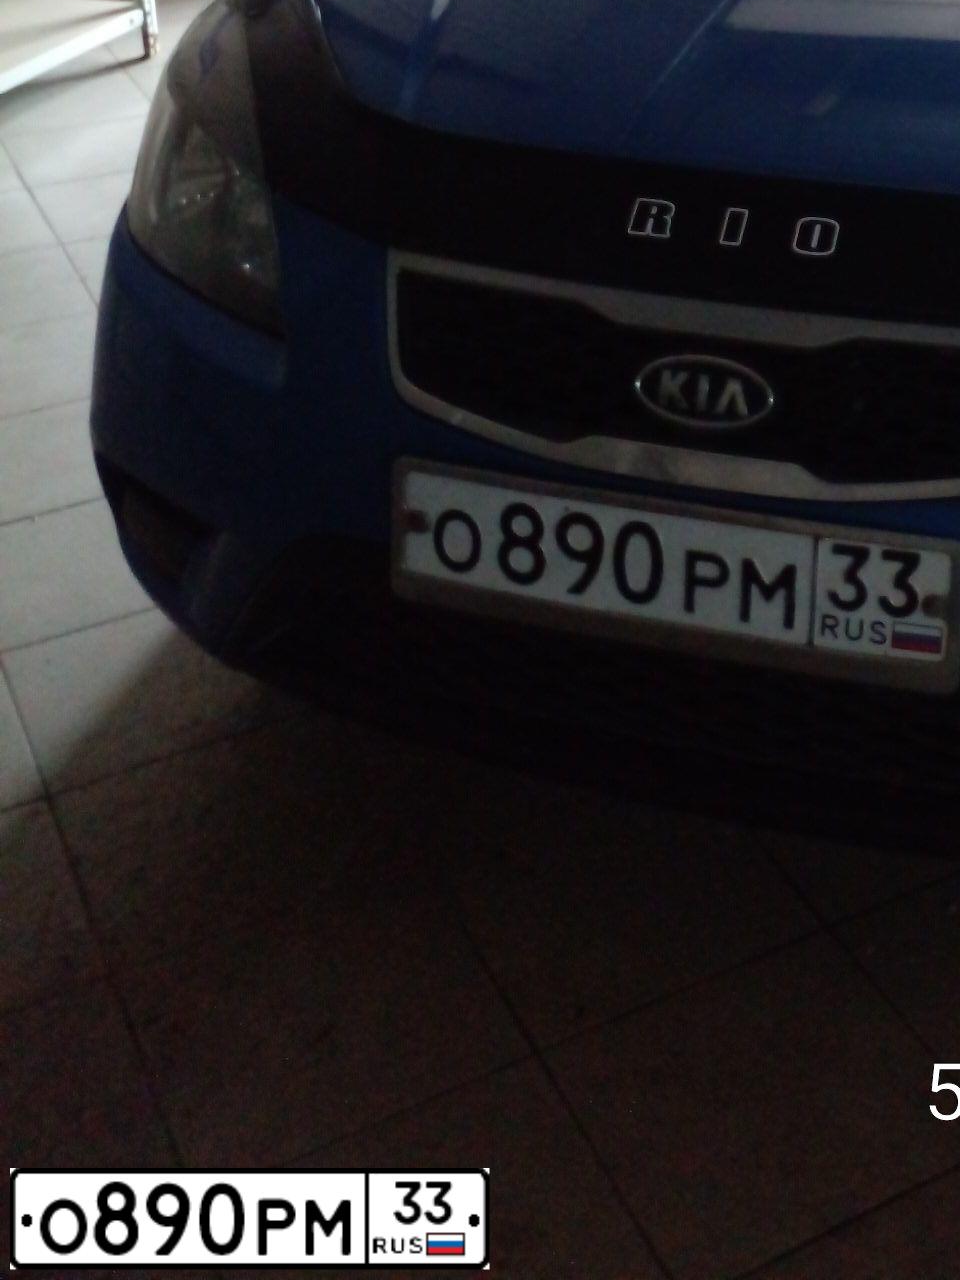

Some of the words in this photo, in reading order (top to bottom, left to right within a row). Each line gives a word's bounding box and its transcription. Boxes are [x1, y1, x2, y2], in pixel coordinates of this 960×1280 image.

[656, 368, 750, 417] KIA
[826, 543, 922, 619] 33
[820, 614, 888, 646] RUS
